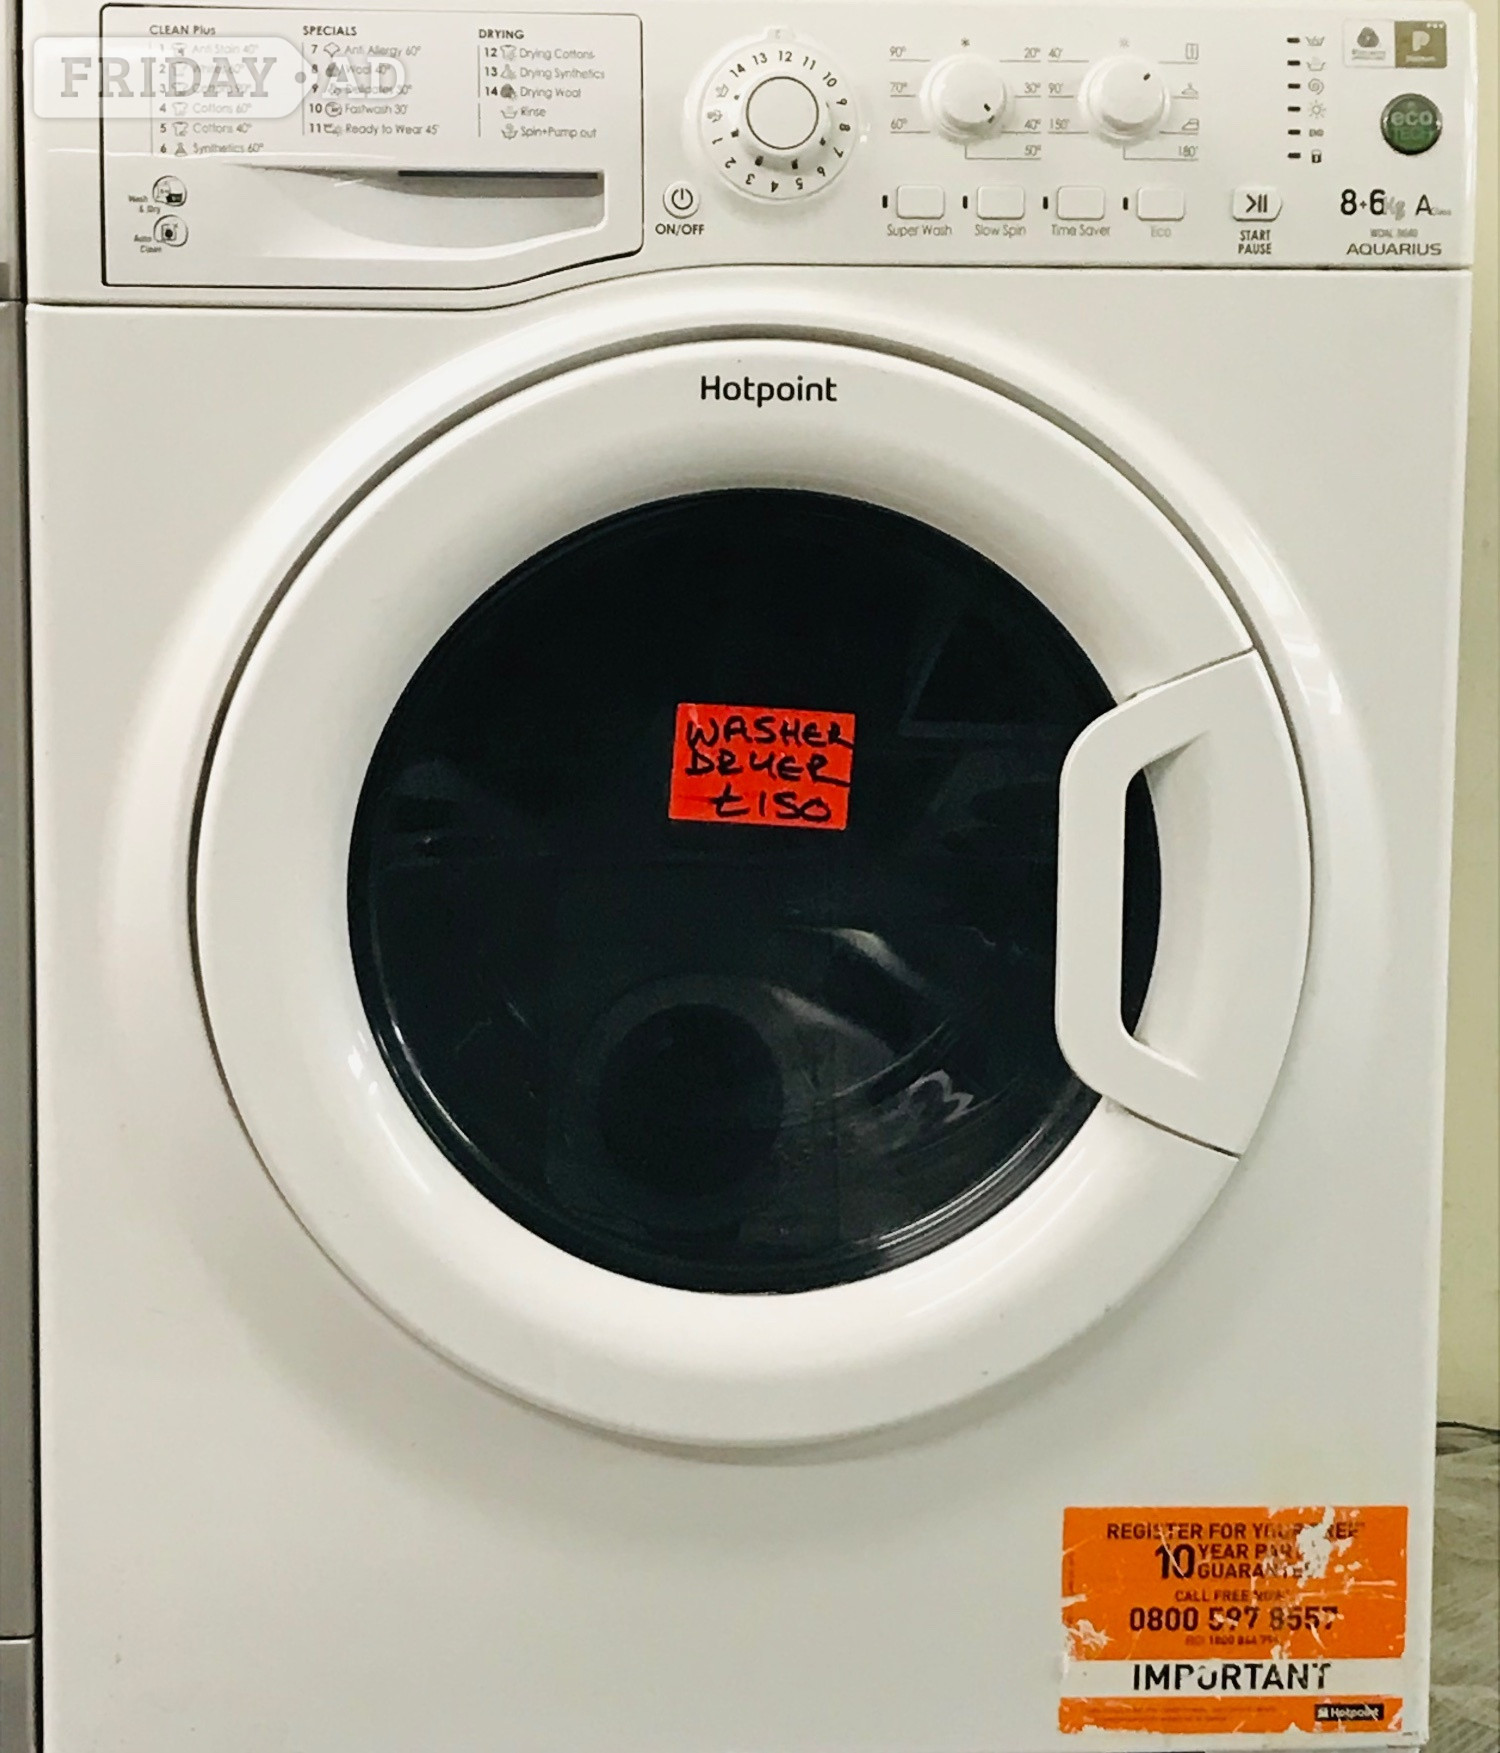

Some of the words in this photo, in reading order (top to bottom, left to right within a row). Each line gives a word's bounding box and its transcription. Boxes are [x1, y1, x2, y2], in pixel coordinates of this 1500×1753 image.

[150, 25, 189, 35] CLEAN
[193, 25, 216, 35] Plus
[303, 26, 357, 36] SPECIALS
[478, 29, 525, 39] DRYING
[1412, 30, 1431, 52] P
[311, 45, 318, 54] 7
[344, 45, 364, 55] Anti
[367, 45, 402, 57] Allergy
[484, 47, 497, 57] 12
[519, 48, 551, 60] Drying
[554, 48, 595, 59] Cottons
[778, 50, 793, 63] 12
[752, 51, 768, 66] 13
[802, 56, 817, 71] 11
[485, 67, 498, 77] 13
[519, 67, 551, 80] Drying
[554, 67, 605, 80] Synthetics
[730, 63, 746, 78] 14
[822, 71, 838, 88] 10
[311, 83, 318, 94] 9
[485, 87, 498, 97] 14
[520, 86, 552, 99] Drying
[555, 86, 581, 98] Wool
[159, 103, 166, 113] 4
[192, 102, 233, 114] Cottons
[309, 103, 322, 114] 10
[520, 106, 546, 118] Rinse
[1391, 110, 1433, 126] eco
[160, 123, 167, 133] 5
[192, 122, 233, 134] Cottons
[309, 123, 321, 133] 11
[345, 123, 378, 136] Ready
[382, 123, 393, 134] to
[395, 123, 423, 134] Wear
[580, 127, 597, 138] out
[839, 123, 851, 132] 8
[712, 137, 723, 145] 1
[160, 143, 167, 153] 6
[193, 142, 245, 154] Synthetics
[833, 147, 844, 158] 7
[724, 157, 737, 169] 2
[745, 173, 756, 185] 3
[795, 177, 804, 190] 5
[770, 181, 779, 193] 4
[655, 223, 705, 236] ON/OFF
[887, 224, 920, 238] Super
[922, 224, 952, 236] Wash
[974, 224, 998, 236] Slow
[1000, 224, 1027, 238] Spin
[1051, 225, 1078, 237] Time
[1080, 225, 1111, 237] Saver
[1151, 226, 1172, 238] Eco
[1240, 230, 1270, 241] START
[1238, 243, 1272, 255] PAUSE
[1346, 243, 1442, 256] AQUARIUS
[700, 375, 837, 407] Hotpoint
[686, 715, 855, 753] WASHER
[685, 747, 853, 788] DRYER
[710, 783, 832, 823] £150
[1106, 1522, 1203, 1540] REGISTER
[1209, 1522, 1246, 1540] FOR
[1155, 1543, 1195, 1580] 10
[1197, 1543, 1249, 1560] YEAR
[1174, 1589, 1206, 1602] CALL
[1213, 1589, 1249, 1602] FREE
[1130, 1606, 1199, 1632] 0800
[1208, 1606, 1260, 1632] 597
[1269, 1606, 1339, 1632] 8557
[1133, 1662, 1332, 1691] IMPORTANT
[1330, 1706, 1379, 1720] Hotpoint
